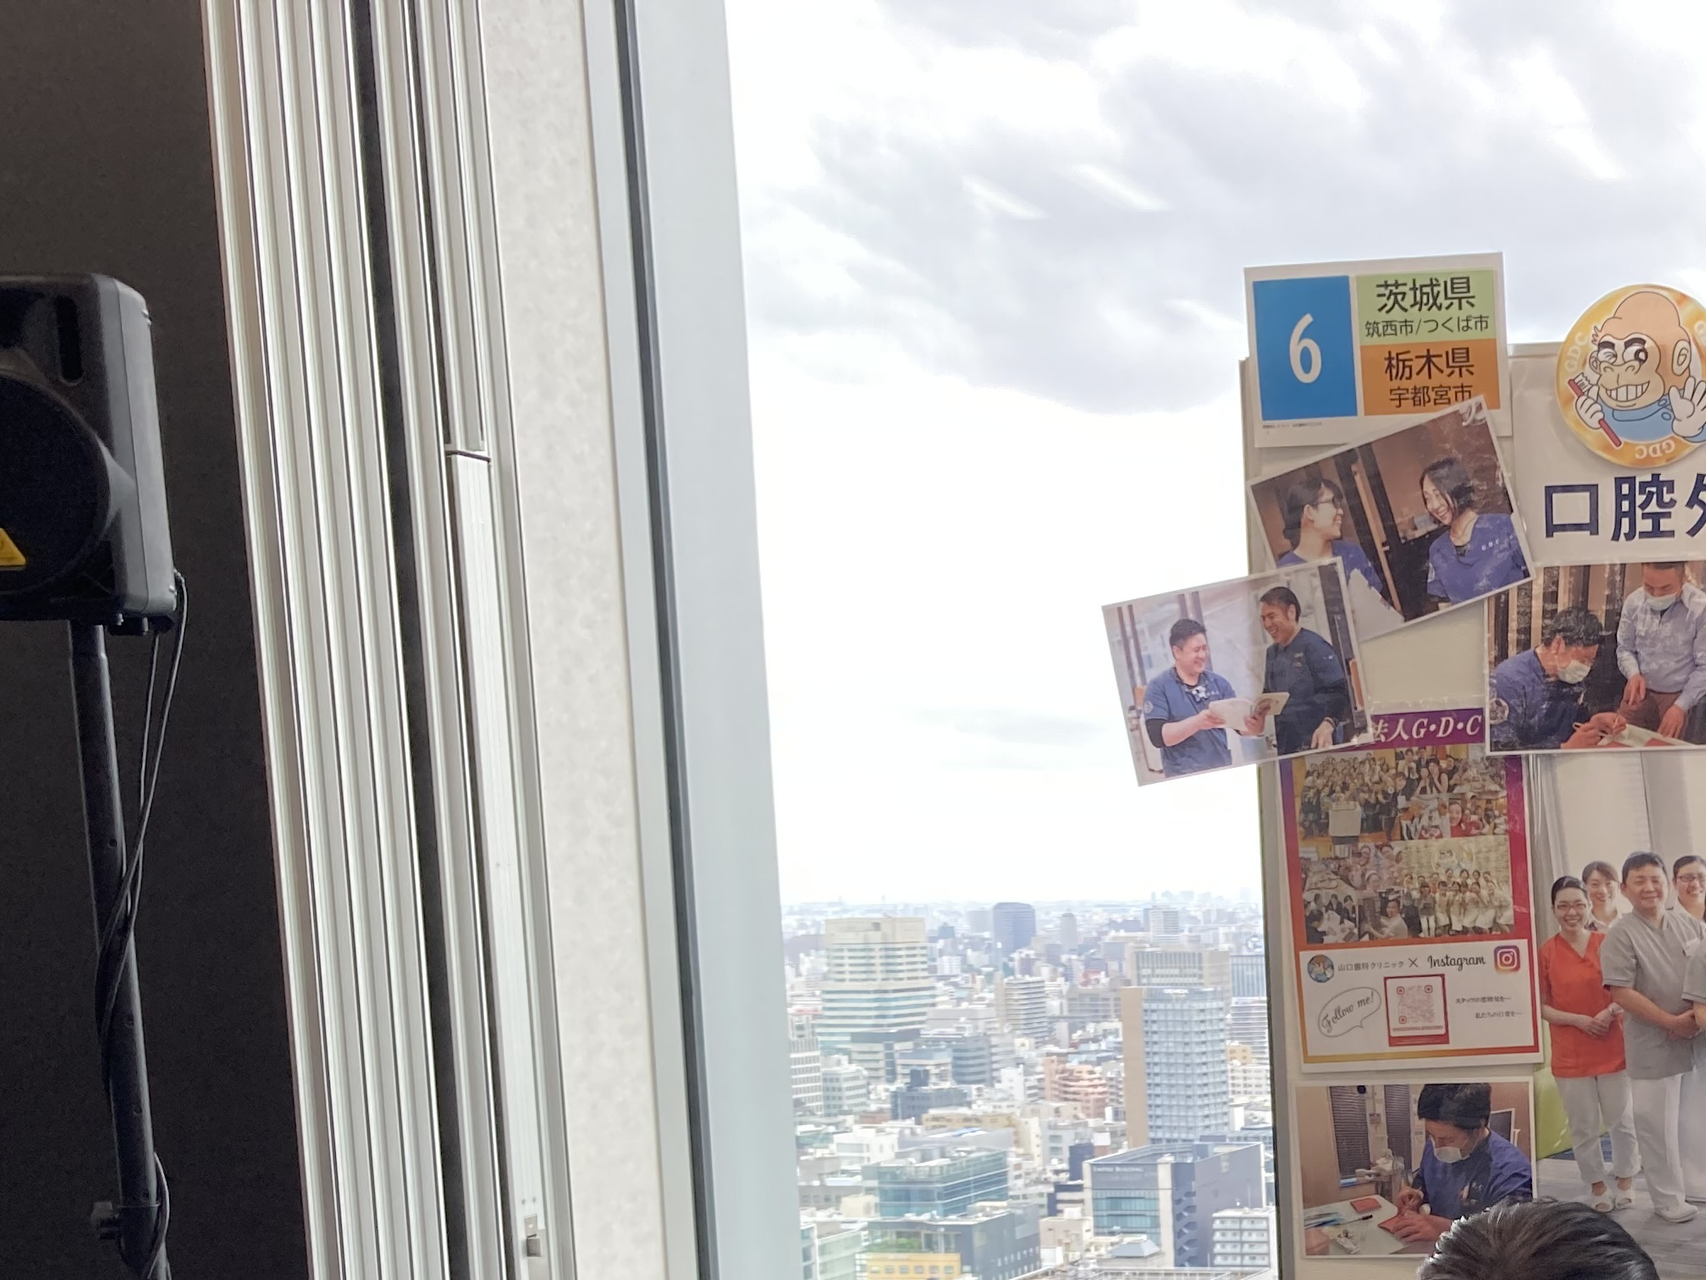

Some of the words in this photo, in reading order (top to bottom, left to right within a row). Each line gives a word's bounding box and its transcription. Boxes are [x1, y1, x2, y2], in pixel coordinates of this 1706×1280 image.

[1376, 276, 1475, 314] 茨城県
[1365, 314, 1489, 338] 筑西市/つくば市
[1287, 313, 1323, 384] 6
[1384, 347, 1474, 381] 栃木県
[1564, 332, 1588, 373] GDC
[1389, 382, 1473, 408] 宇都宮市
[1634, 439, 1676, 460] GDC
[1338, 961, 1405, 973] 山口歯科クリニック
[1427, 954, 1487, 972] Instagram
[1320, 1004, 1355, 1035] Follow
[1356, 991, 1375, 1009] me!
